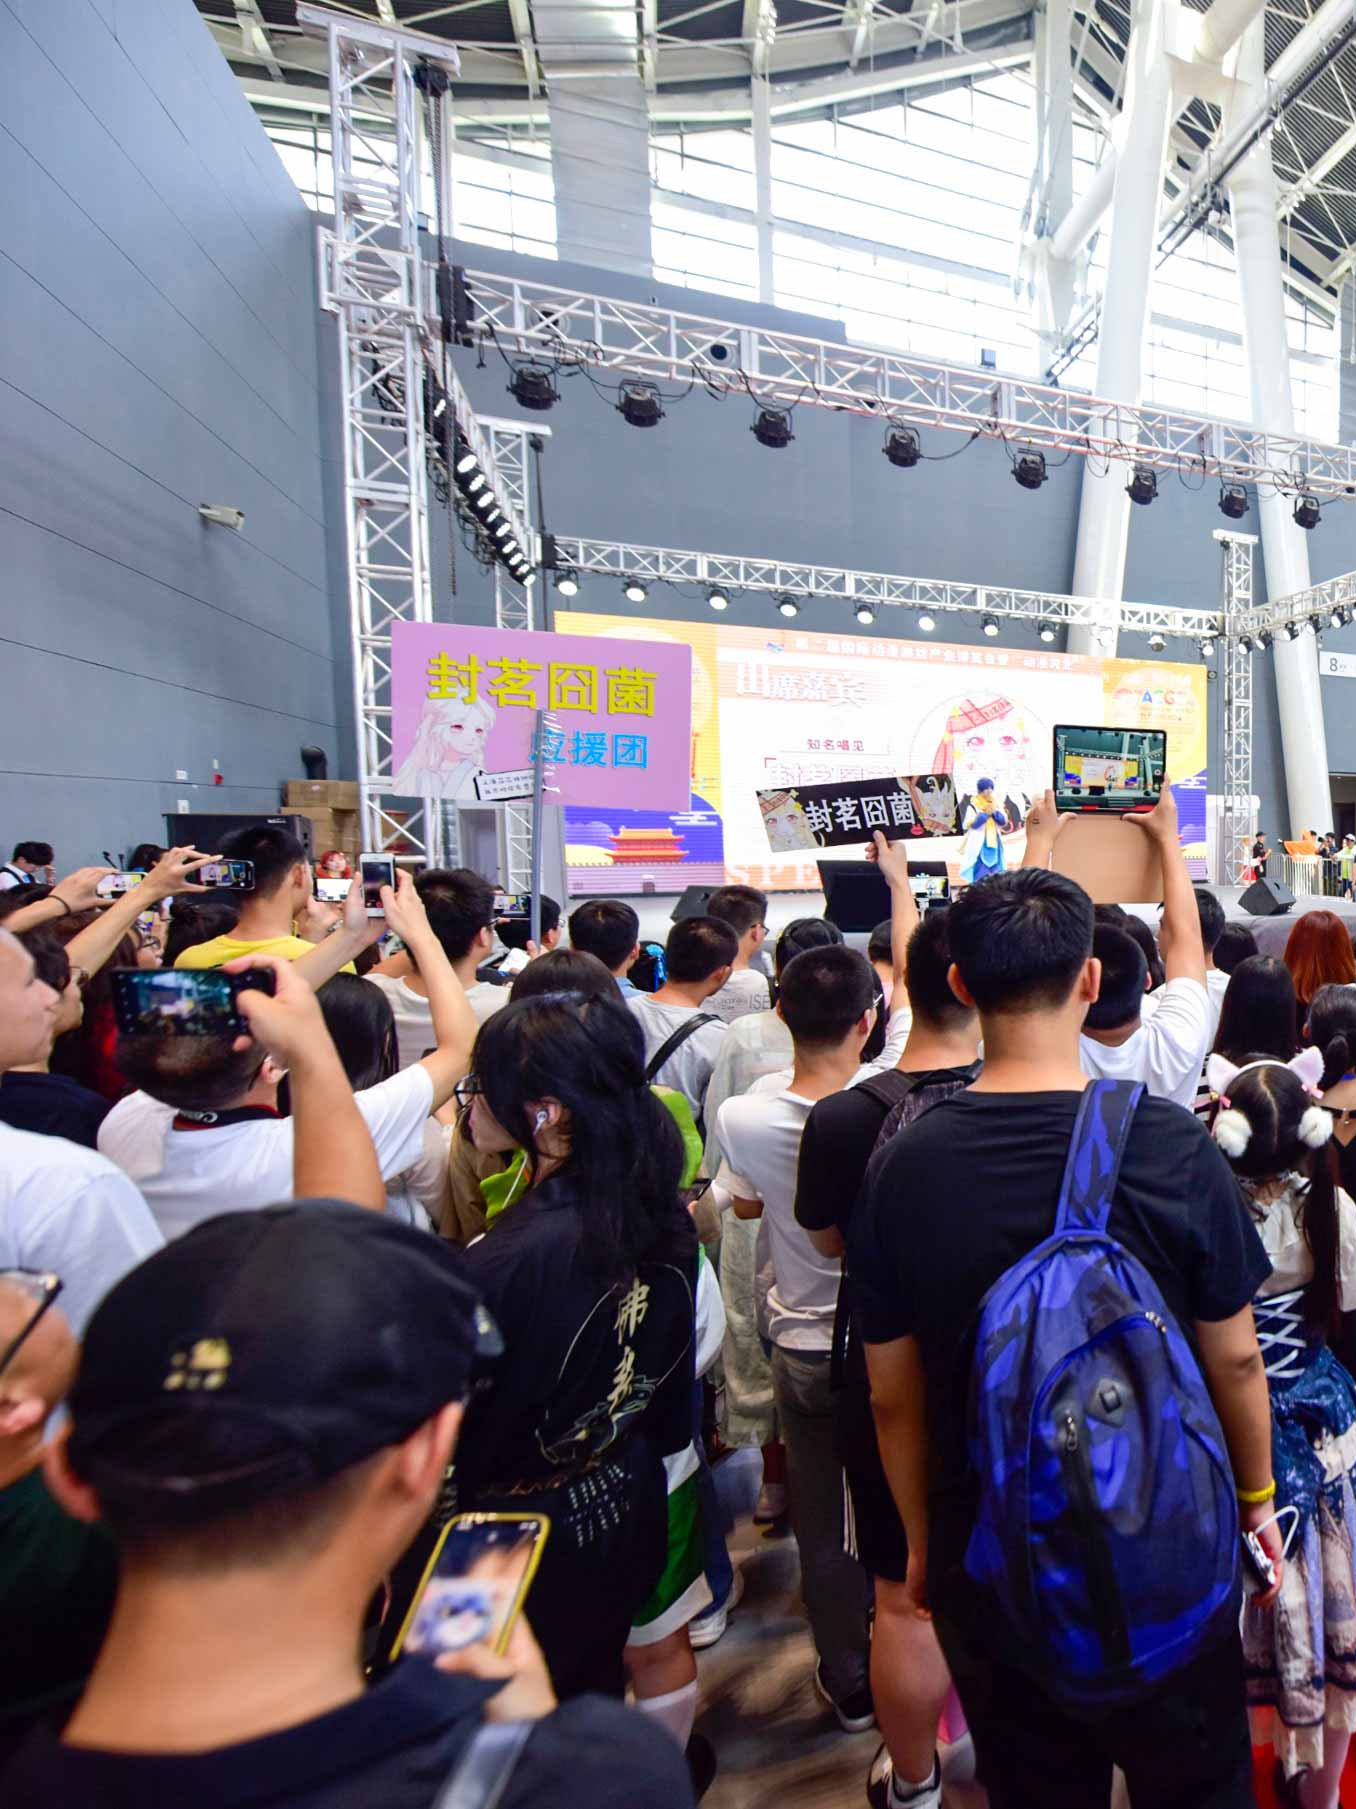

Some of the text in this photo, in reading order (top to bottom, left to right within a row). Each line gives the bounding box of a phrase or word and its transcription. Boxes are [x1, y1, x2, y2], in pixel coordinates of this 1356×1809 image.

[426, 652, 659, 717] 封茗囧菌
[1329, 657, 1338, 672] 8
[529, 729, 648, 770] 应援团
[807, 738, 865, 752] 知名唱见
[805, 792, 916, 833] 封茗囧菌
